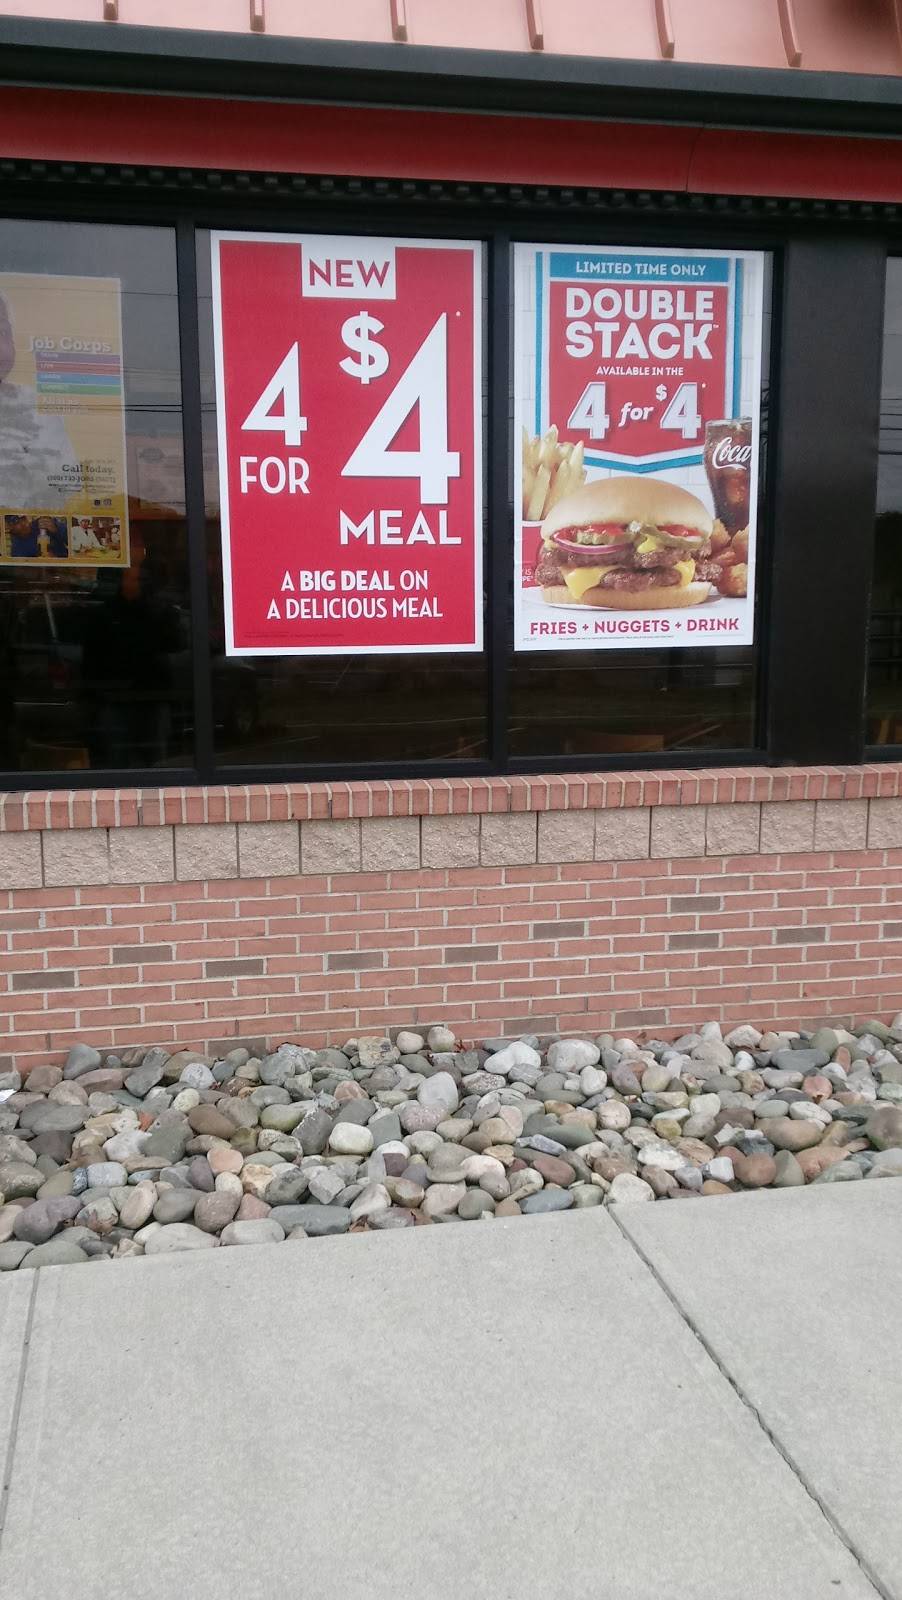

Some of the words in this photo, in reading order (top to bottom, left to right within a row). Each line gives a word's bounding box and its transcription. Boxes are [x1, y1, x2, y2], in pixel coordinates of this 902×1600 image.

[308, 258, 391, 288] NEW
[575, 261, 632, 275] LIMITED
[635, 262, 667, 276] TIME
[671, 264, 707, 276] ONLY
[565, 287, 714, 321] DOUBLE
[60, 336, 112, 354] Corps
[596, 366, 650, 376] AVAILABLE
[651, 366, 664, 376] IN
[666, 366, 684, 376] THE
[240, 340, 308, 447] 4
[566, 381, 610, 440] 4
[618, 402, 655, 427] for
[711, 436, 753, 470] Coca
[62, 464, 83, 474] Call
[239, 455, 311, 495] FOR
[338, 508, 463, 546] MEAL
[280, 570, 295, 592] A
[299, 570, 336, 592] BIG
[340, 569, 395, 592] DEAL
[400, 569, 428, 591] ON
[266, 598, 281, 620] A
[285, 597, 387, 619] DELICIOUS
[392, 596, 443, 618] MEAL
[529, 620, 578, 636] FRIES
[594, 619, 671, 634] NUGGETS
[686, 617, 740, 632] DRINK
